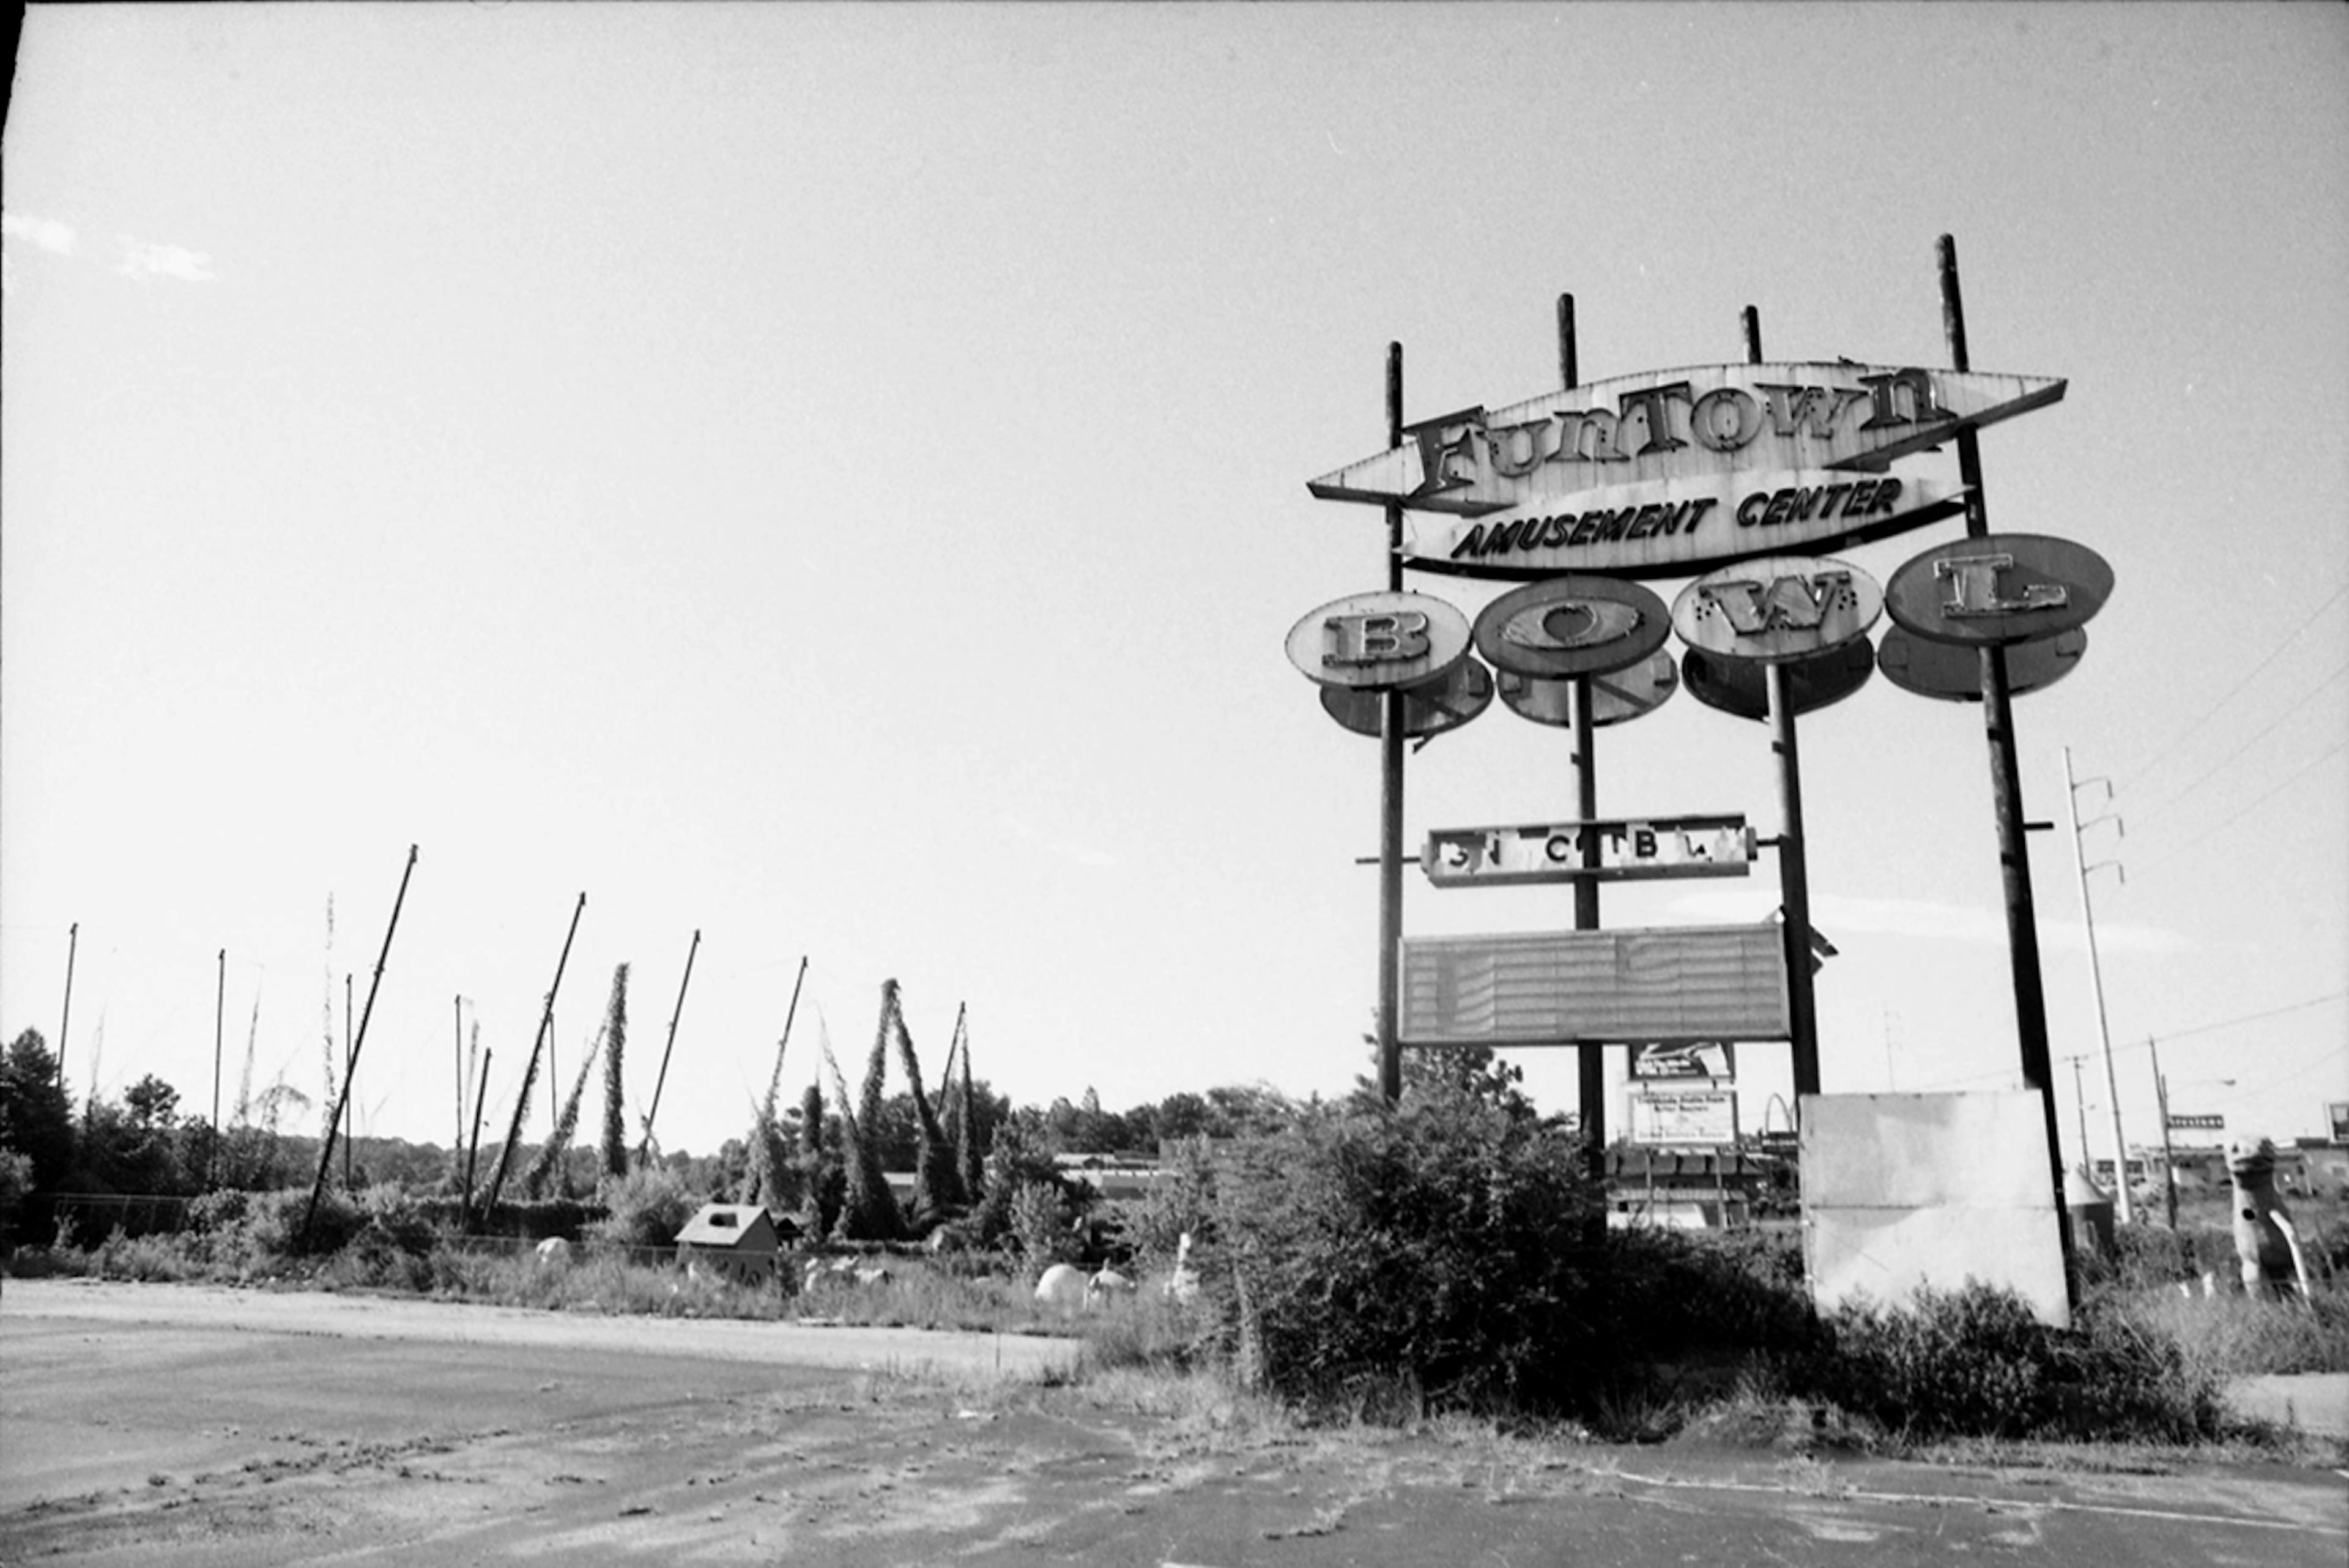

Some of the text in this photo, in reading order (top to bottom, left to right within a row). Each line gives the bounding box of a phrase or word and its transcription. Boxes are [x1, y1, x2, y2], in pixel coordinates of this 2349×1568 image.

[1450, 478, 1903, 558] AMUSEMENT CENTER
[1321, 553, 2068, 669] BOWL
